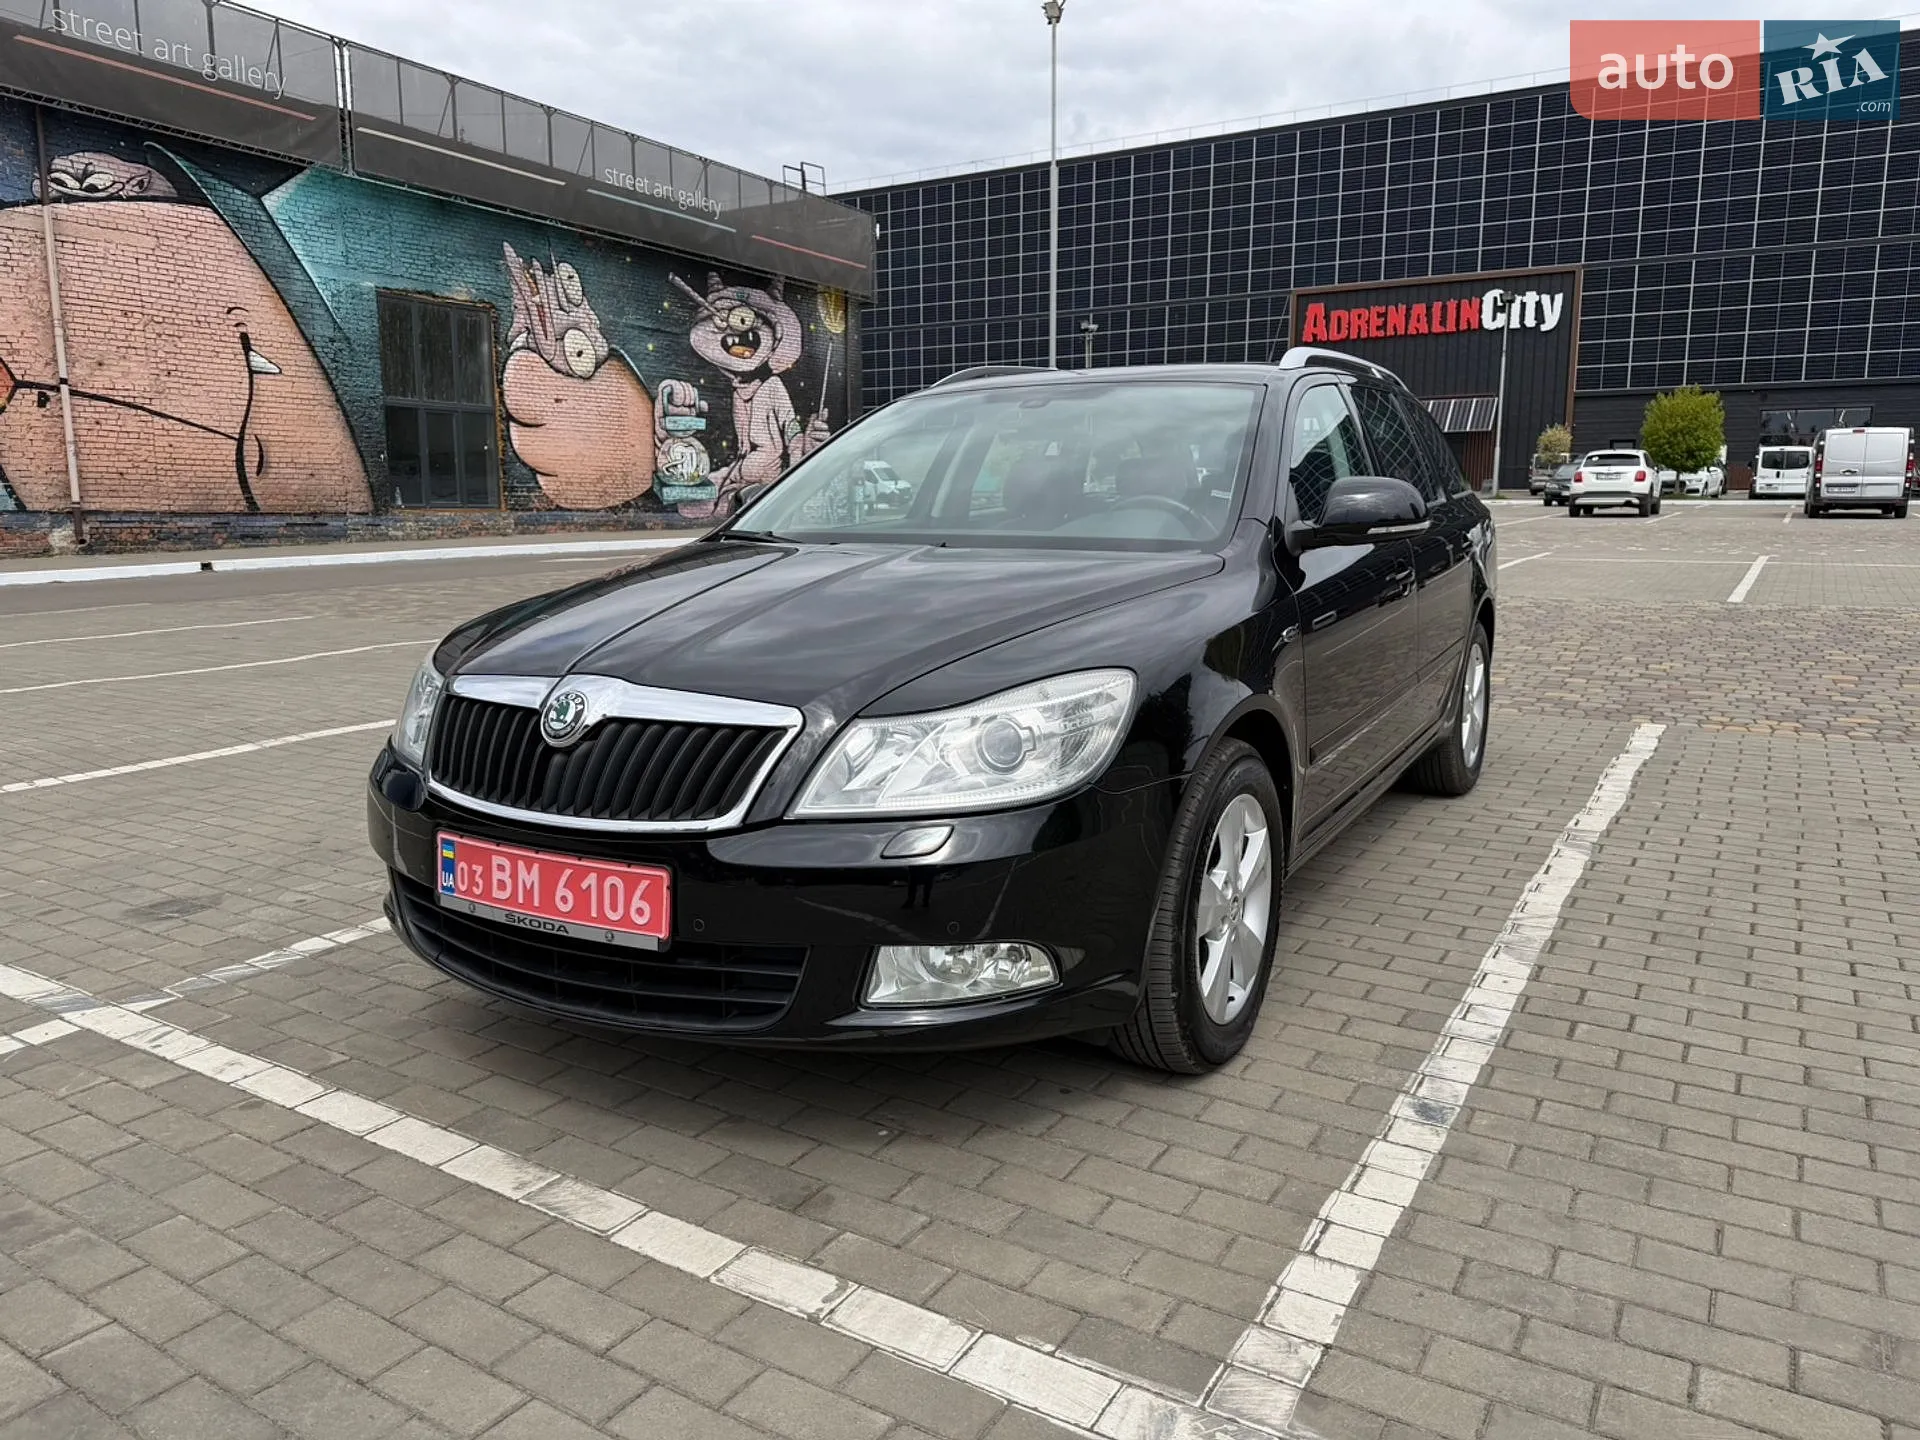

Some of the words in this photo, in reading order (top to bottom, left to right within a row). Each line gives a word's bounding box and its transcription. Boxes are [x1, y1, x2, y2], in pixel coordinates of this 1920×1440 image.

[51, 8, 143, 53] street
[153, 36, 194, 68] art
[202, 52, 287, 100] gallery
[605, 167, 650, 195] street
[653, 182, 674, 202] art
[678, 188, 721, 220] gallery
[442, 871, 455, 888] UA
[456, 861, 484, 896] 03
[491, 855, 540, 908] BM
[554, 868, 652, 926] 6106
